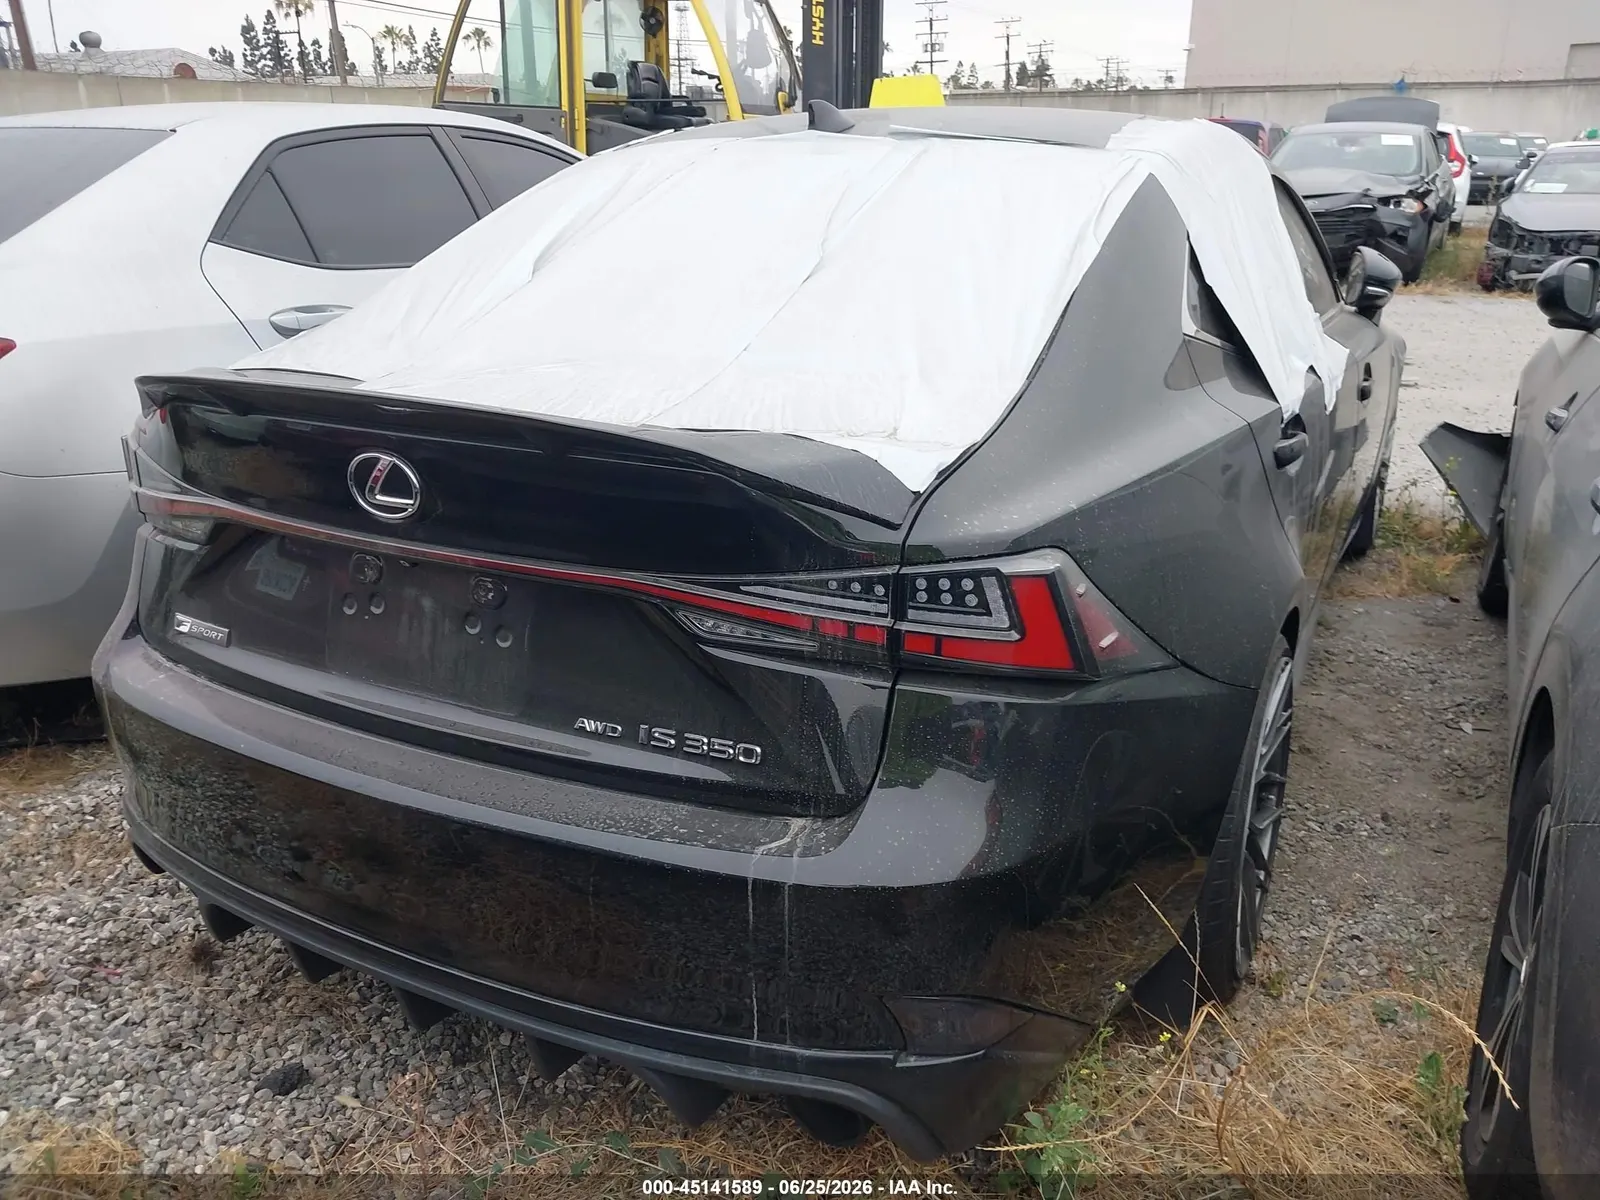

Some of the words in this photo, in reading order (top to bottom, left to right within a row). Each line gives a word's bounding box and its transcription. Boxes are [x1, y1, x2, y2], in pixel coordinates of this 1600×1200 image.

[190, 625, 225, 640] SPORT
[573, 717, 623, 737] AWD
[638, 724, 677, 749] IS
[682, 732, 762, 765] 350
